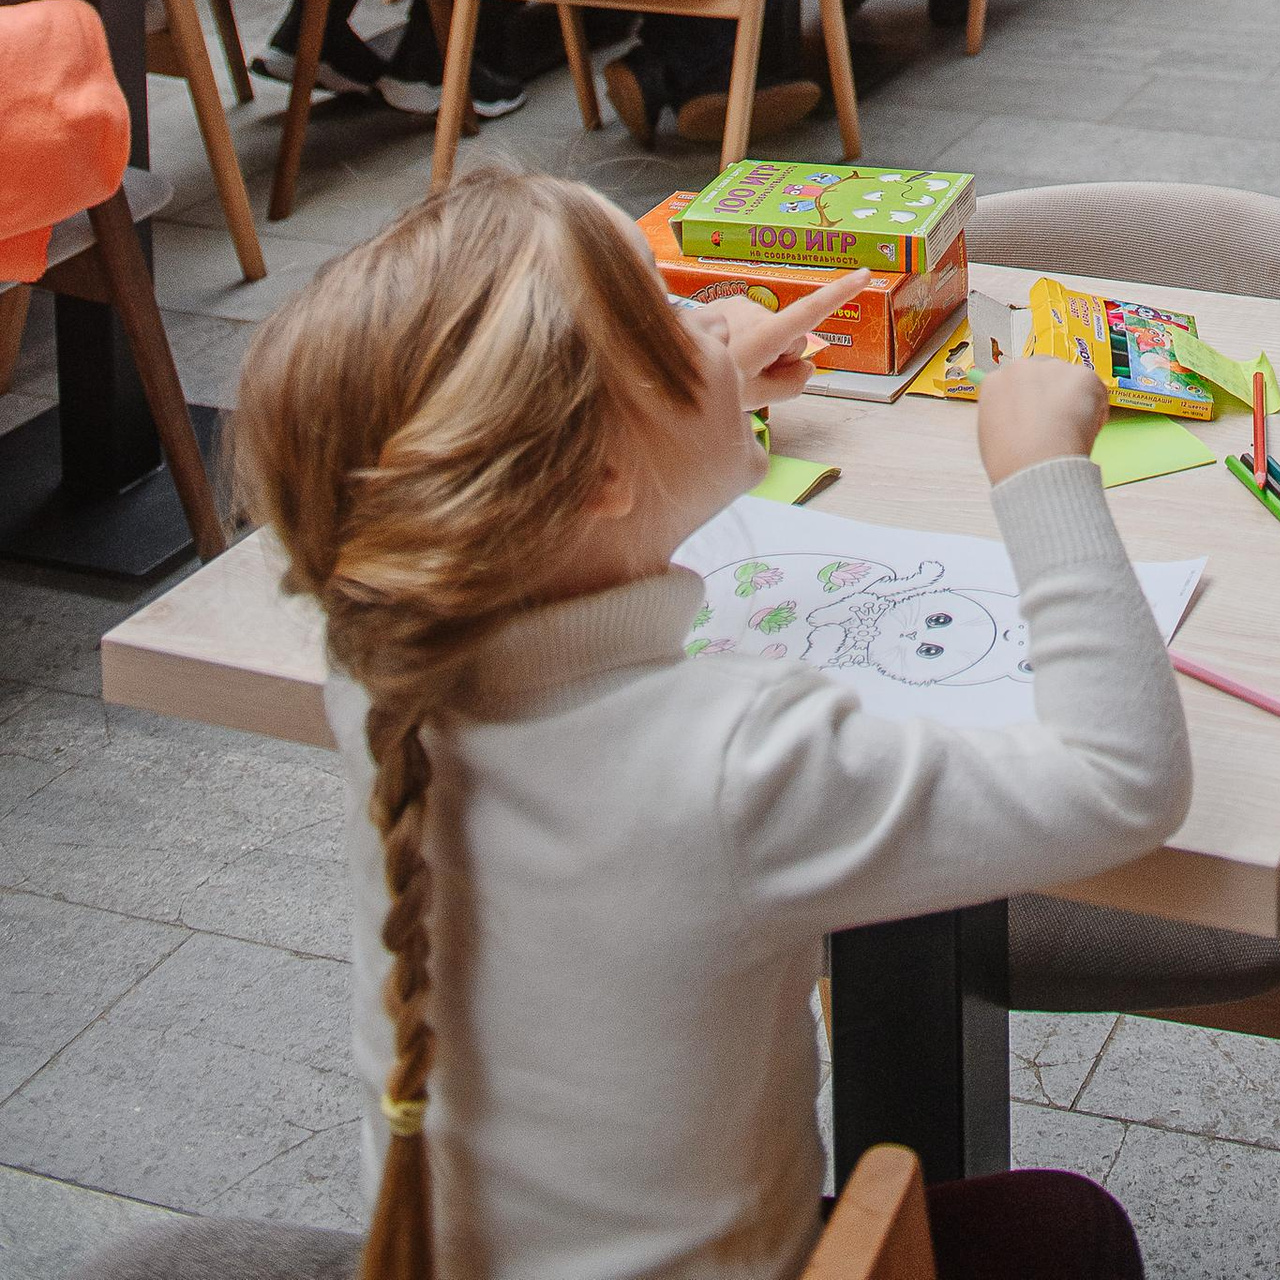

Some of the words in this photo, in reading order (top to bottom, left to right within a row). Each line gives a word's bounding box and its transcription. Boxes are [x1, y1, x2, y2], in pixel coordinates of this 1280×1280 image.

[714, 188, 756, 213] 100
[739, 165, 780, 186] ИГР
[748, 226, 797, 250] 100
[806, 229, 857, 254] ИГР
